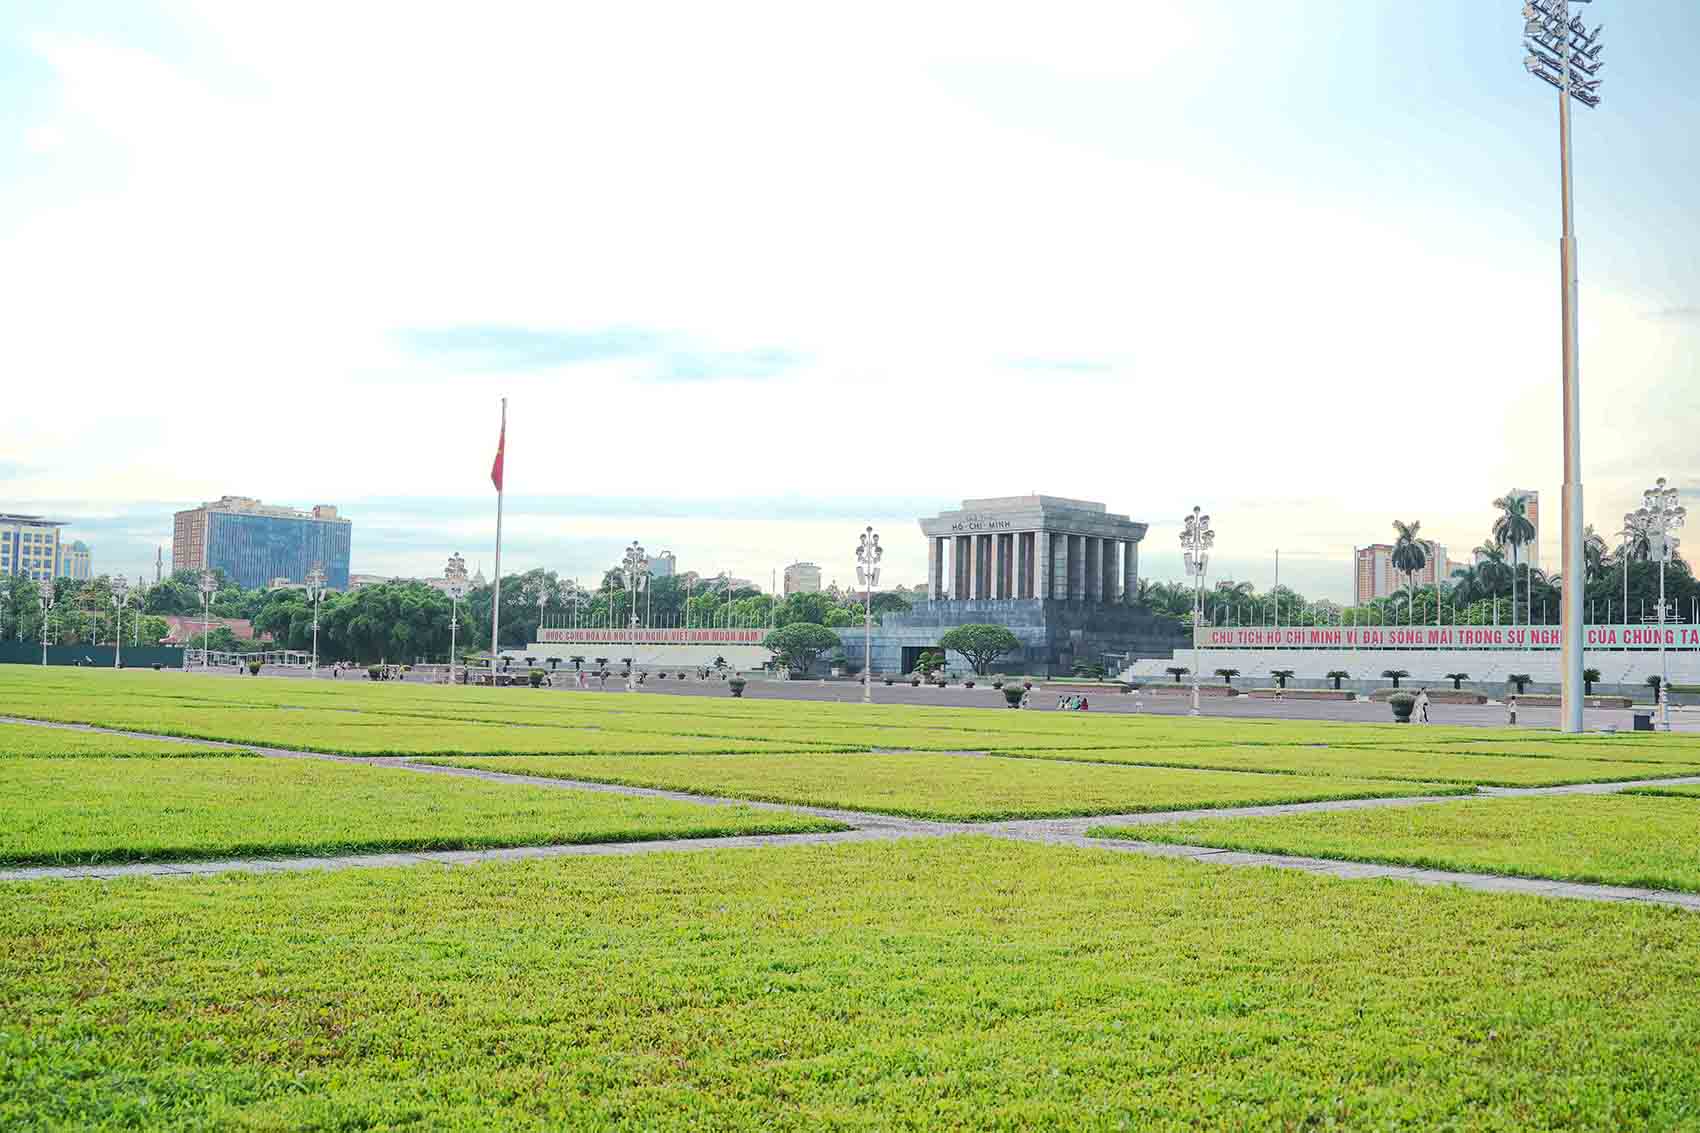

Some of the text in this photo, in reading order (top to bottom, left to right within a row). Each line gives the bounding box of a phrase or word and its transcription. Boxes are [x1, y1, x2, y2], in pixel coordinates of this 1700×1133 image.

[1311, 631, 1341, 643] MINH
[1458, 630, 1502, 644] TRONG
[1588, 625, 1616, 644] CỦA
[1623, 626, 1674, 644] CHÚNG
[1680, 629, 1699, 644] TA
